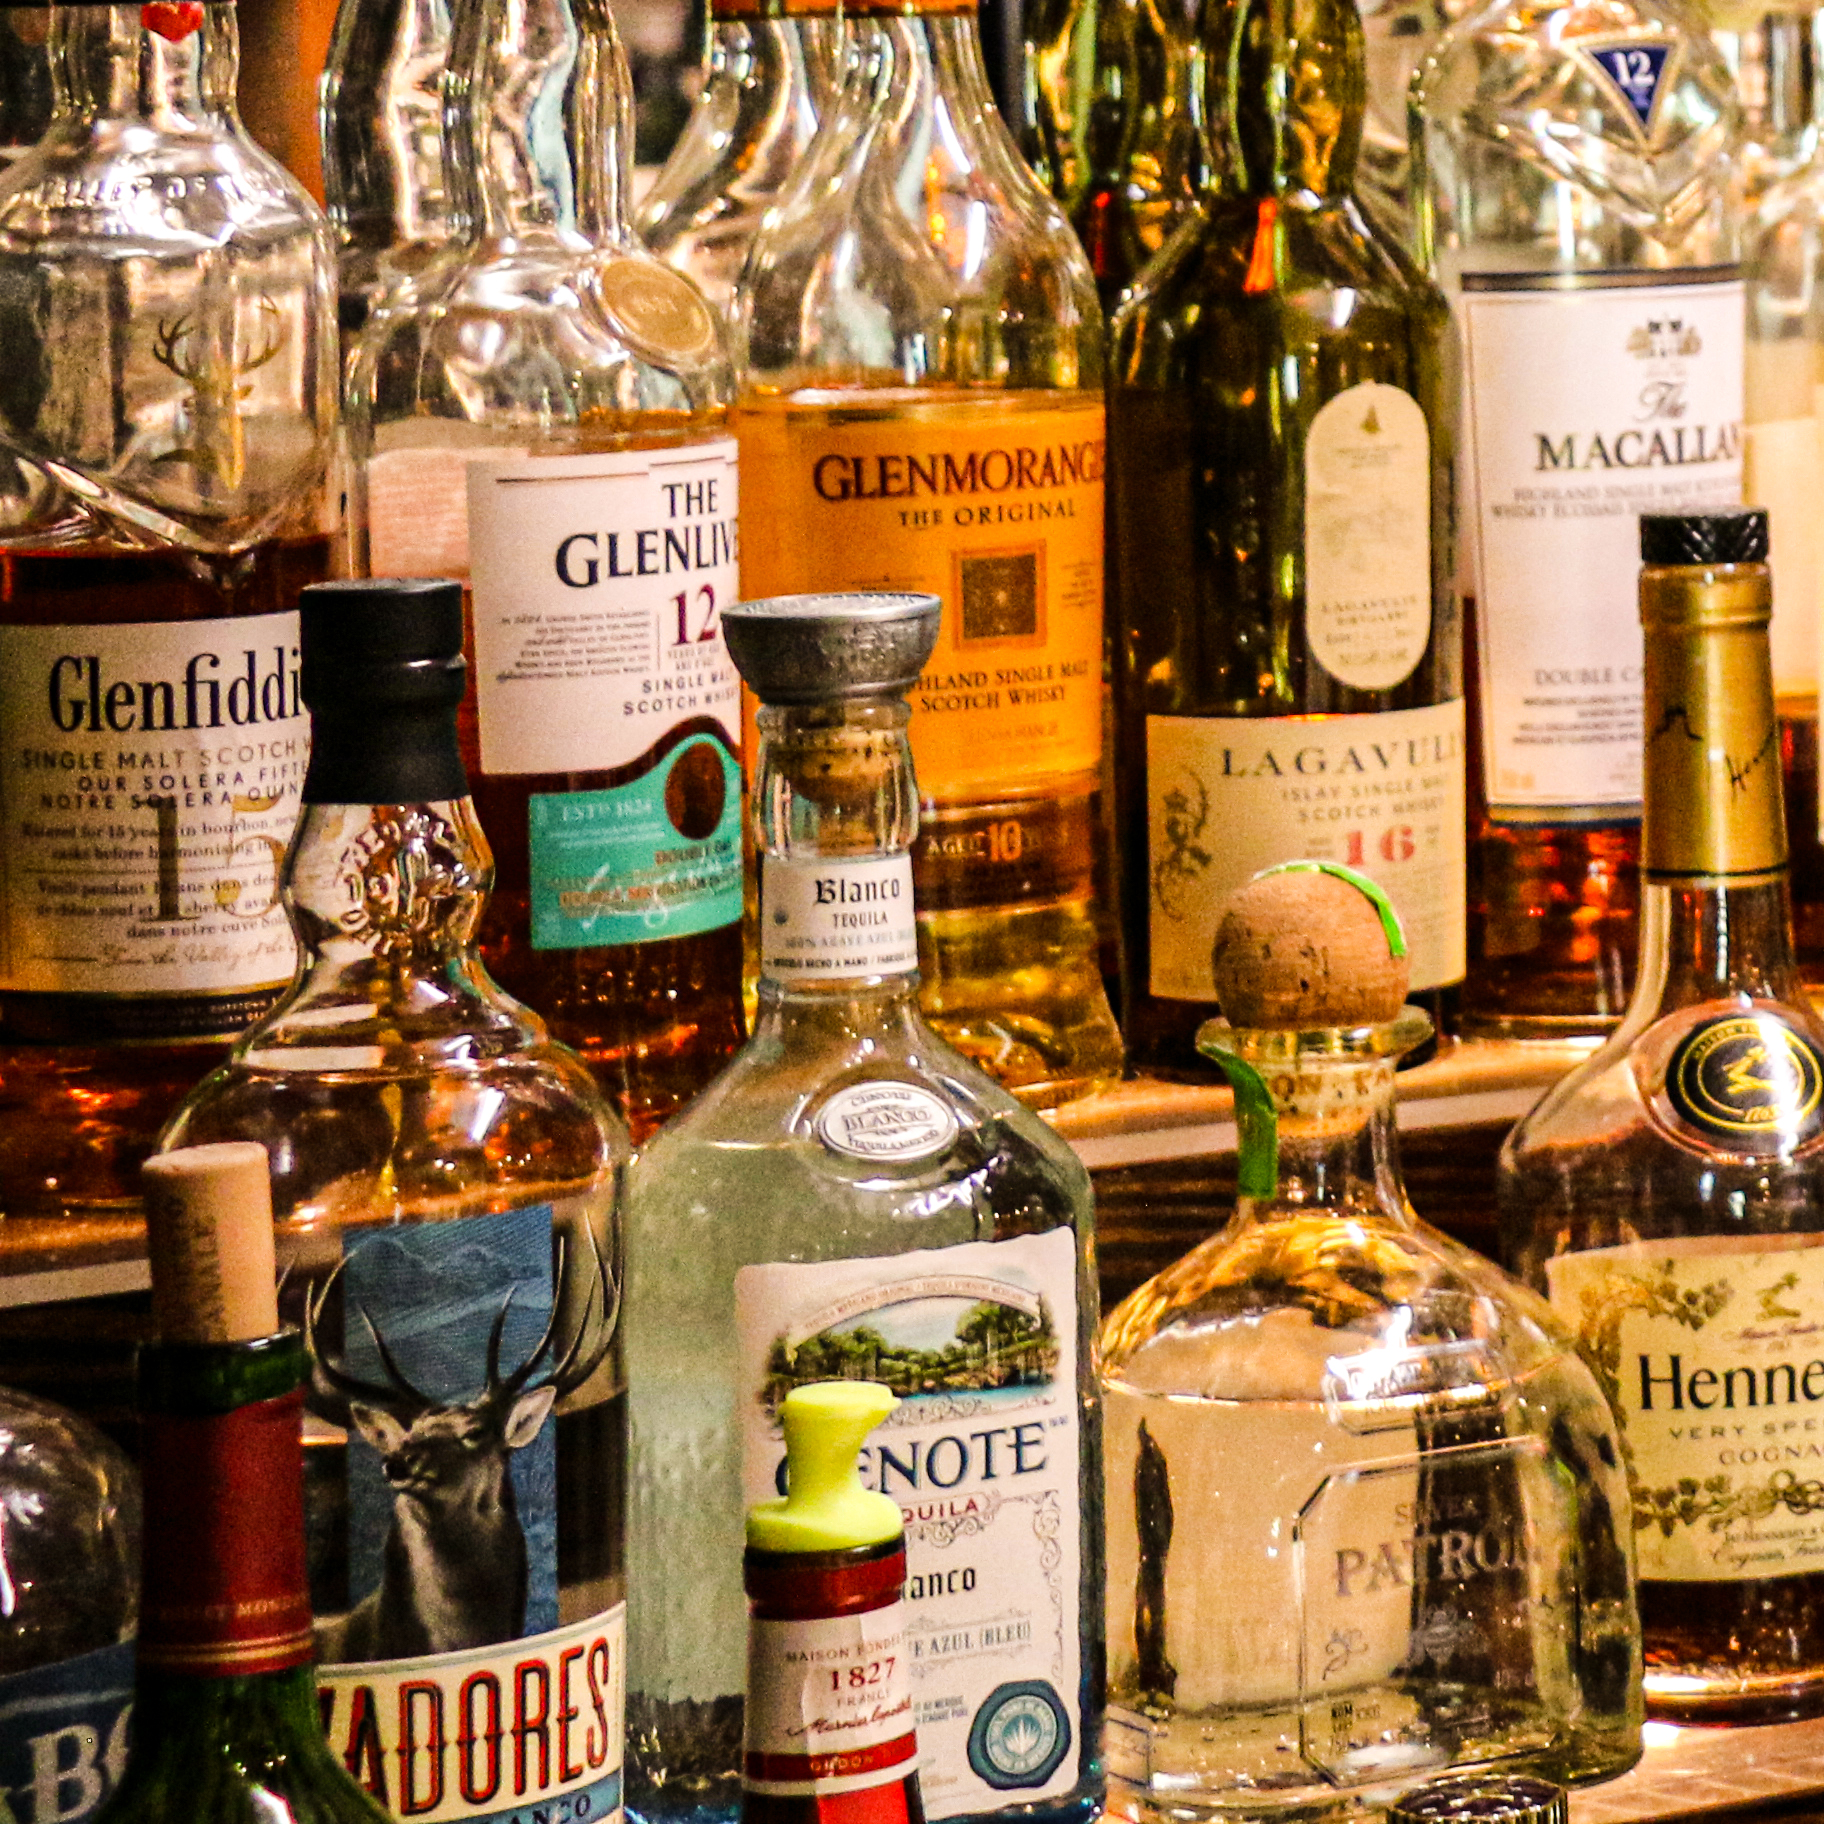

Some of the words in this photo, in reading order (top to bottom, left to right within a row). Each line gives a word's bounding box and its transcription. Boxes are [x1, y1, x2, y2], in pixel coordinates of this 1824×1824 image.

[1613, 51, 1655, 86] 12
[813, 440, 1103, 502] GLENMORANG
[662, 479, 718, 518] THE
[900, 509, 942, 527] THE
[954, 498, 1075, 526] ORIGINAL
[670, 583, 716, 646] 12
[50, 646, 302, 732] Glenfiddi
[642, 674, 704, 694] SINGLE
[994, 665, 1053, 684] SINGLE
[623, 696, 697, 716] SCOTCH
[921, 692, 1000, 712] SCOTCH
[23, 748, 102, 771] SINGLE
[117, 749, 186, 769] MALT
[200, 741, 296, 767] SCOTCH
[79, 776, 127, 793] OUR
[143, 771, 244, 790] SOLERA
[259, 761, 307, 782] FIFTE
[41, 794, 115, 810] NOTRE
[131, 790, 232, 810] SOLERA
[247, 782, 298, 802] QUIN
[989, 820, 1023, 862] 10
[1346, 825, 1415, 866] 16
[814, 877, 901, 905] Blanco
[832, 912, 888, 929] TEQUILA
[1669, 1425, 1746, 1441] VERY
[902, 1497, 979, 1524] QUILA
[903, 1565, 976, 1600] anco
[930, 1633, 975, 1654] AZUL
[829, 1657, 897, 1692] 1827
